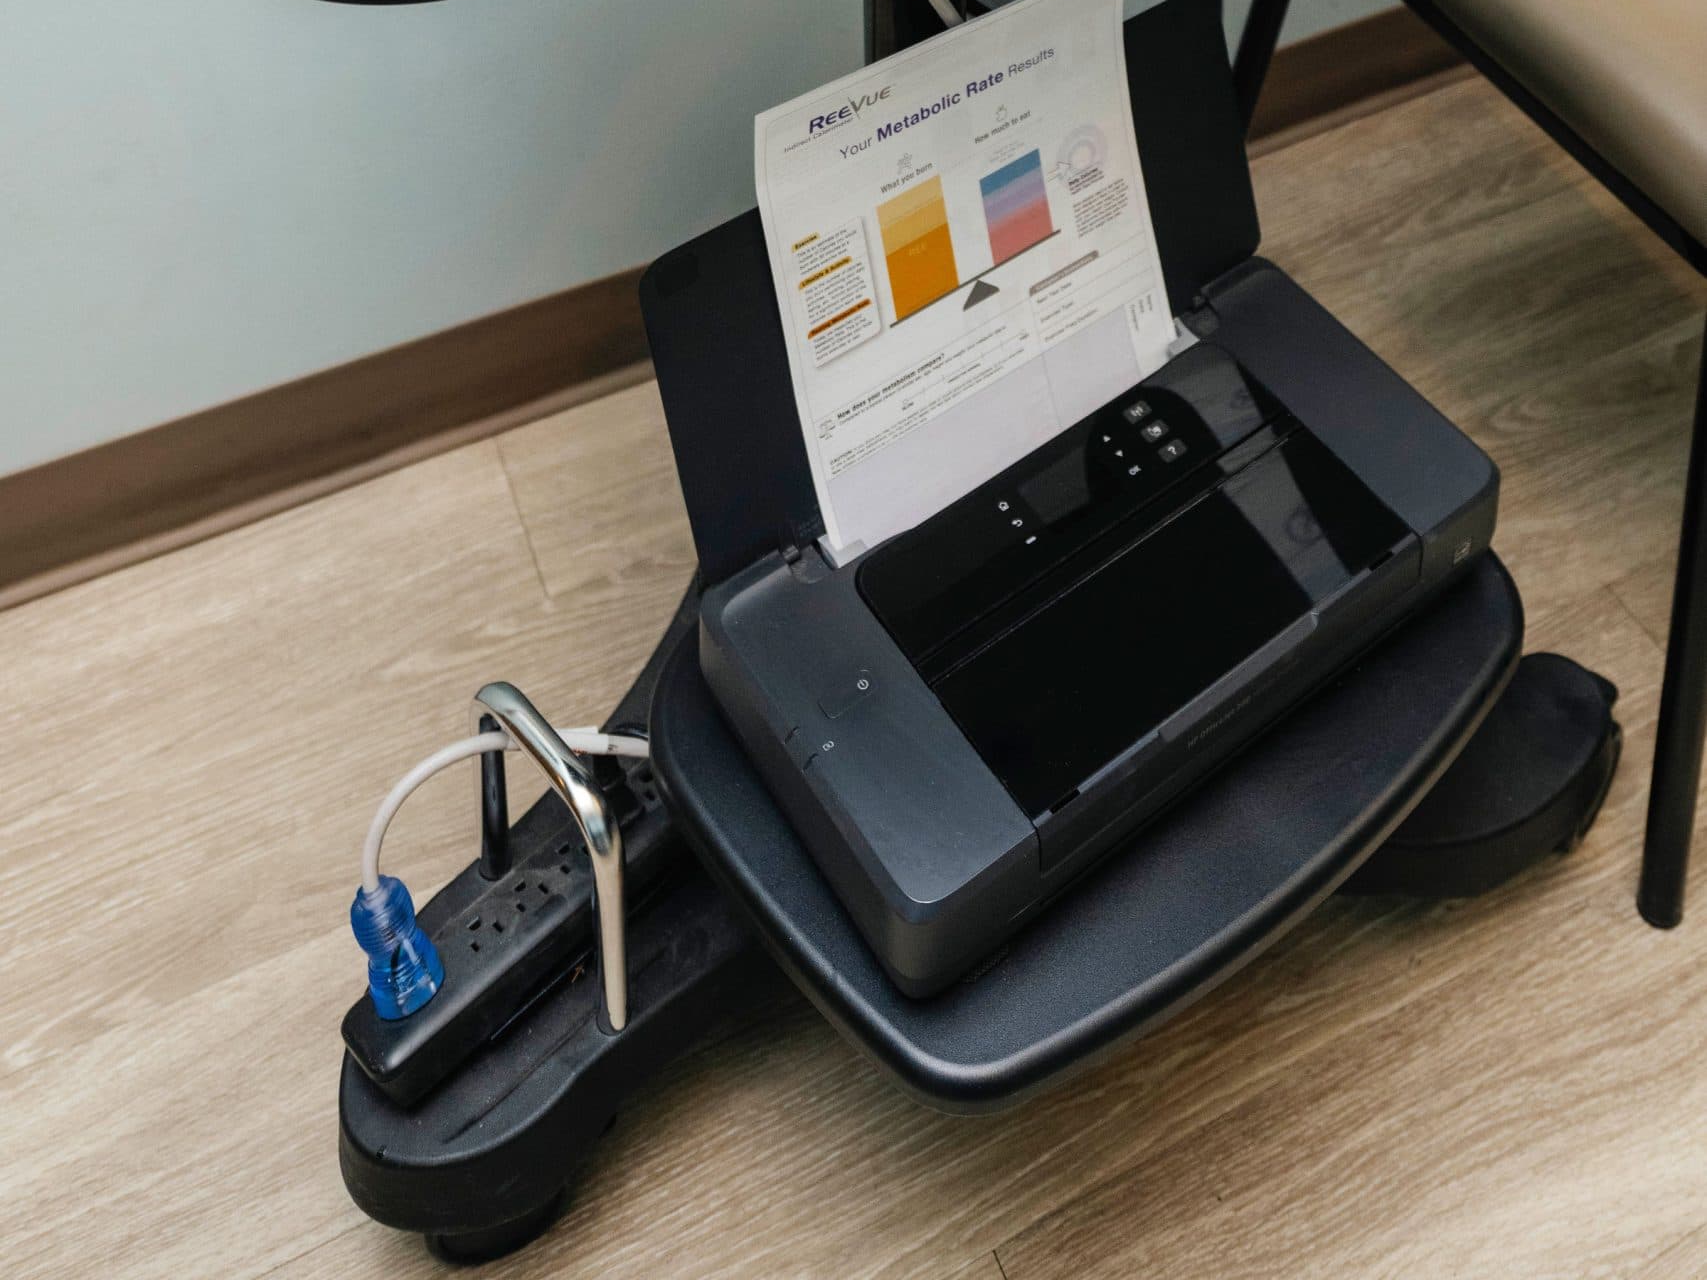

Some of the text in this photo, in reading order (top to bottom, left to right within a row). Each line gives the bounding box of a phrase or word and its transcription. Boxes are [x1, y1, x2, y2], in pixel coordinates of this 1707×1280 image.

[839, 47, 1055, 160] Your Metabolic Rate Results
[880, 178, 900, 194] What
[901, 171, 915, 185] you
